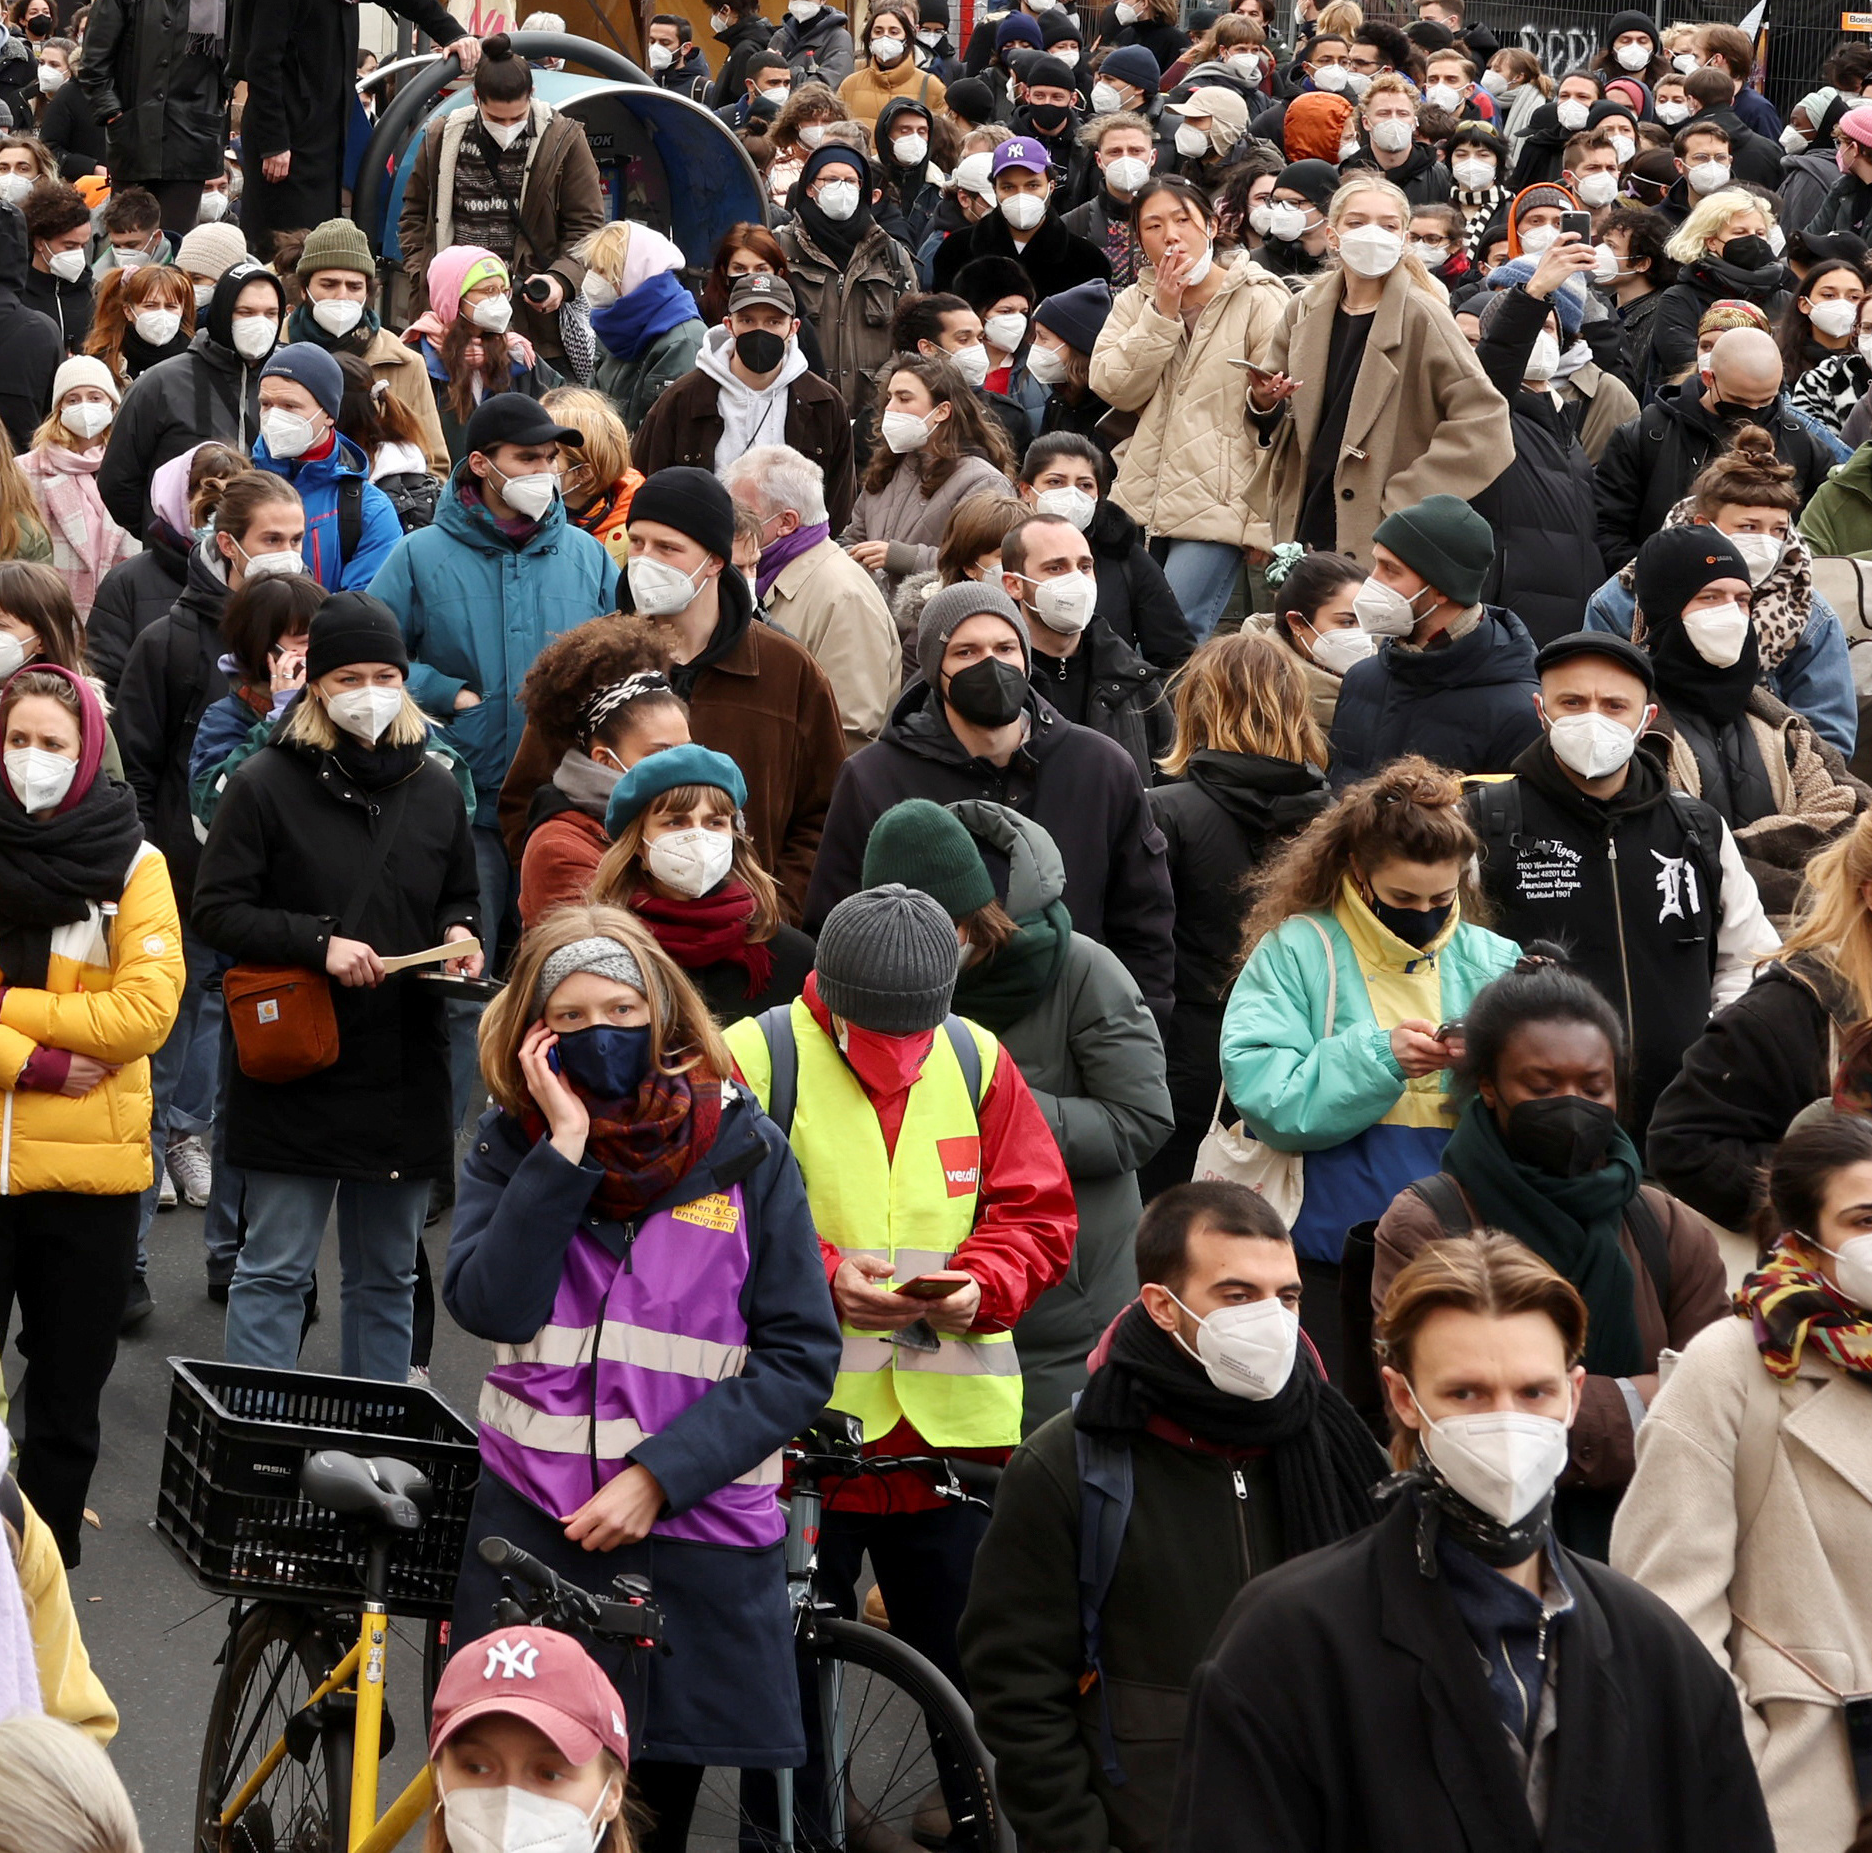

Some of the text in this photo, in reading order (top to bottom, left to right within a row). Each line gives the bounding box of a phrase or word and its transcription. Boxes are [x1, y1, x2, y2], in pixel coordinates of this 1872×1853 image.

[1849, 14, 1872, 24] Boels
[1549, 839, 1583, 863] Tigers
[1516, 861, 1533, 870] 2100
[1540, 869, 1560, 878] 48201
[1516, 878, 1583, 890] American League
[1555, 890, 1571, 899] 1901
[722, 1208, 738, 1220] Co
[675, 1208, 735, 1233] enteignen!
[482, 1639, 540, 1681] NY
